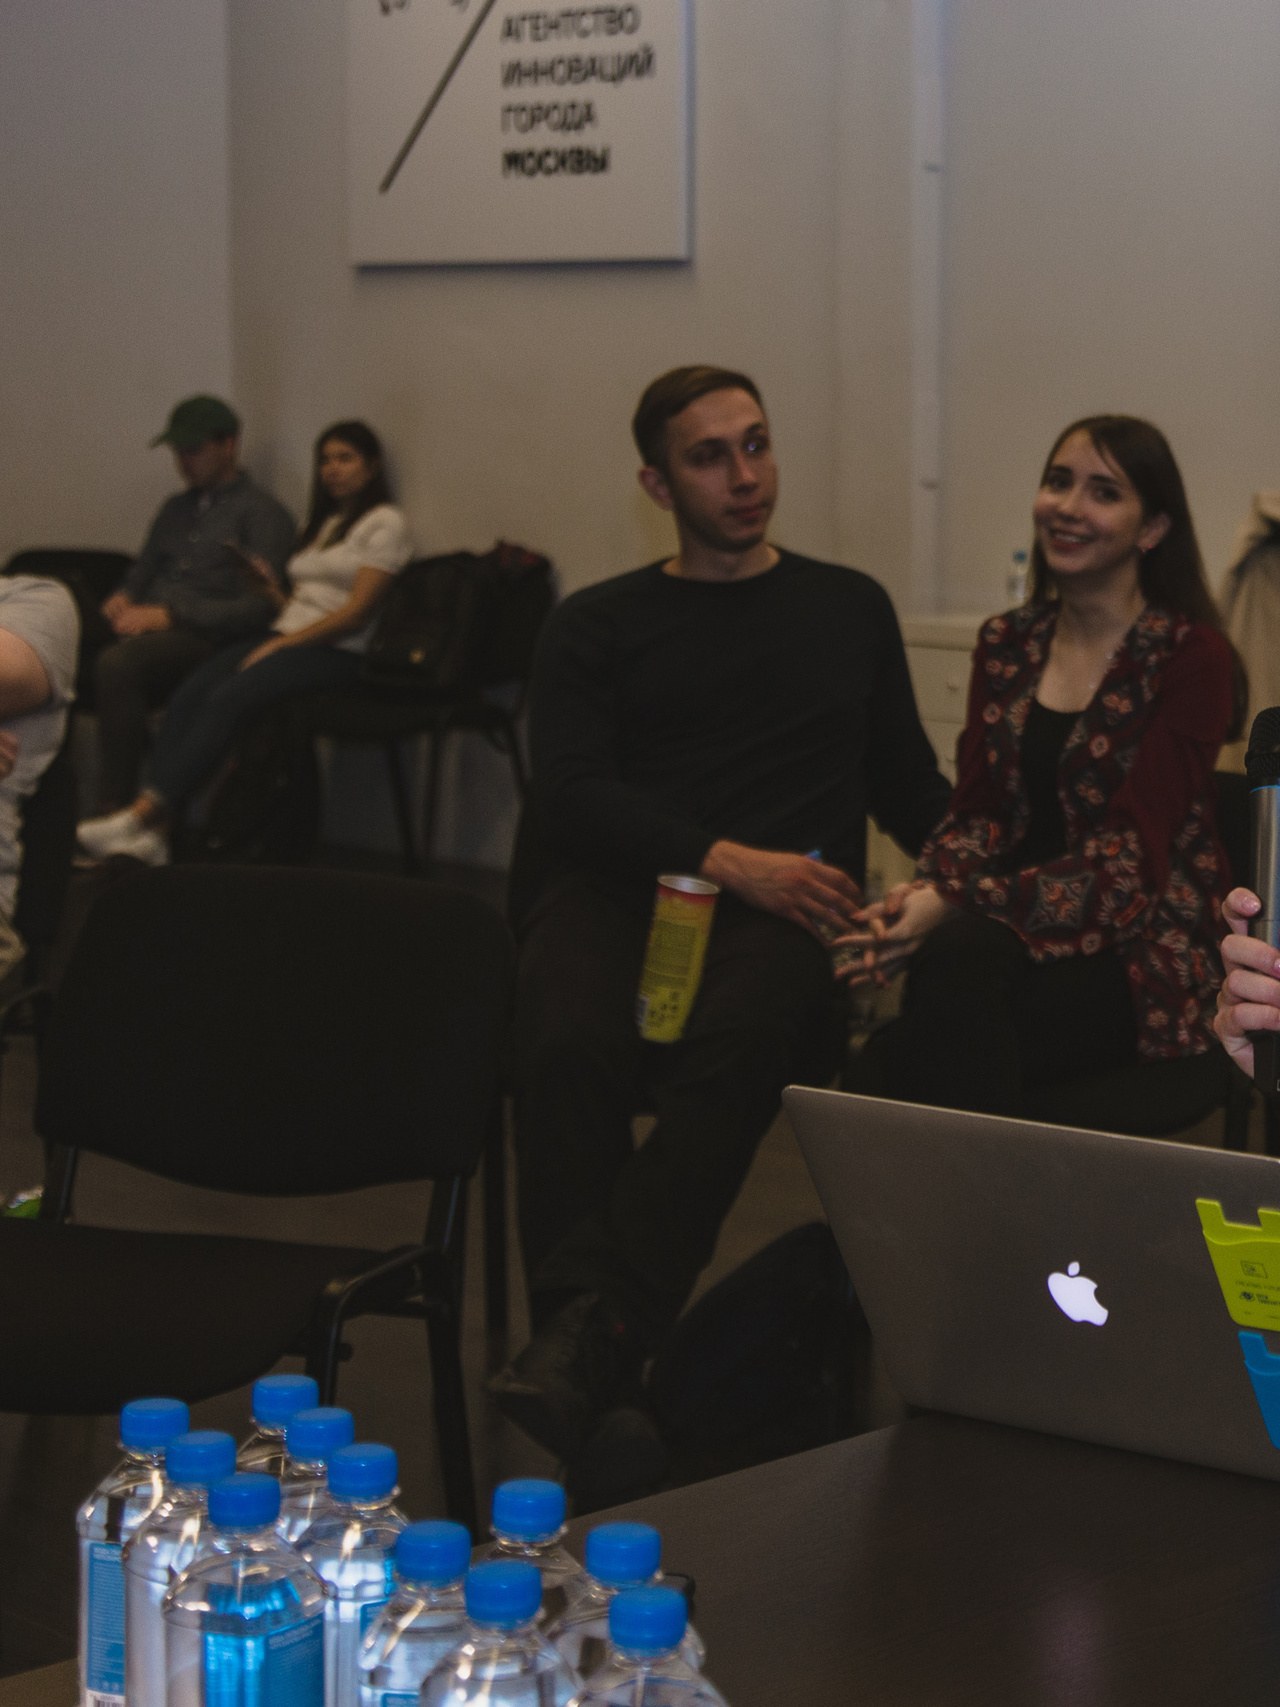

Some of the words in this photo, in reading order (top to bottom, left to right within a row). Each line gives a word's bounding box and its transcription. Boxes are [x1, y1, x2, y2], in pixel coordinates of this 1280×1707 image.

[501, 4, 642, 42] АГЕНТСТВО
[501, 44, 656, 88] ИННОВАЦИЙ
[501, 101, 597, 134] ГОРОДА
[502, 146, 610, 178] МОСКВЫ
